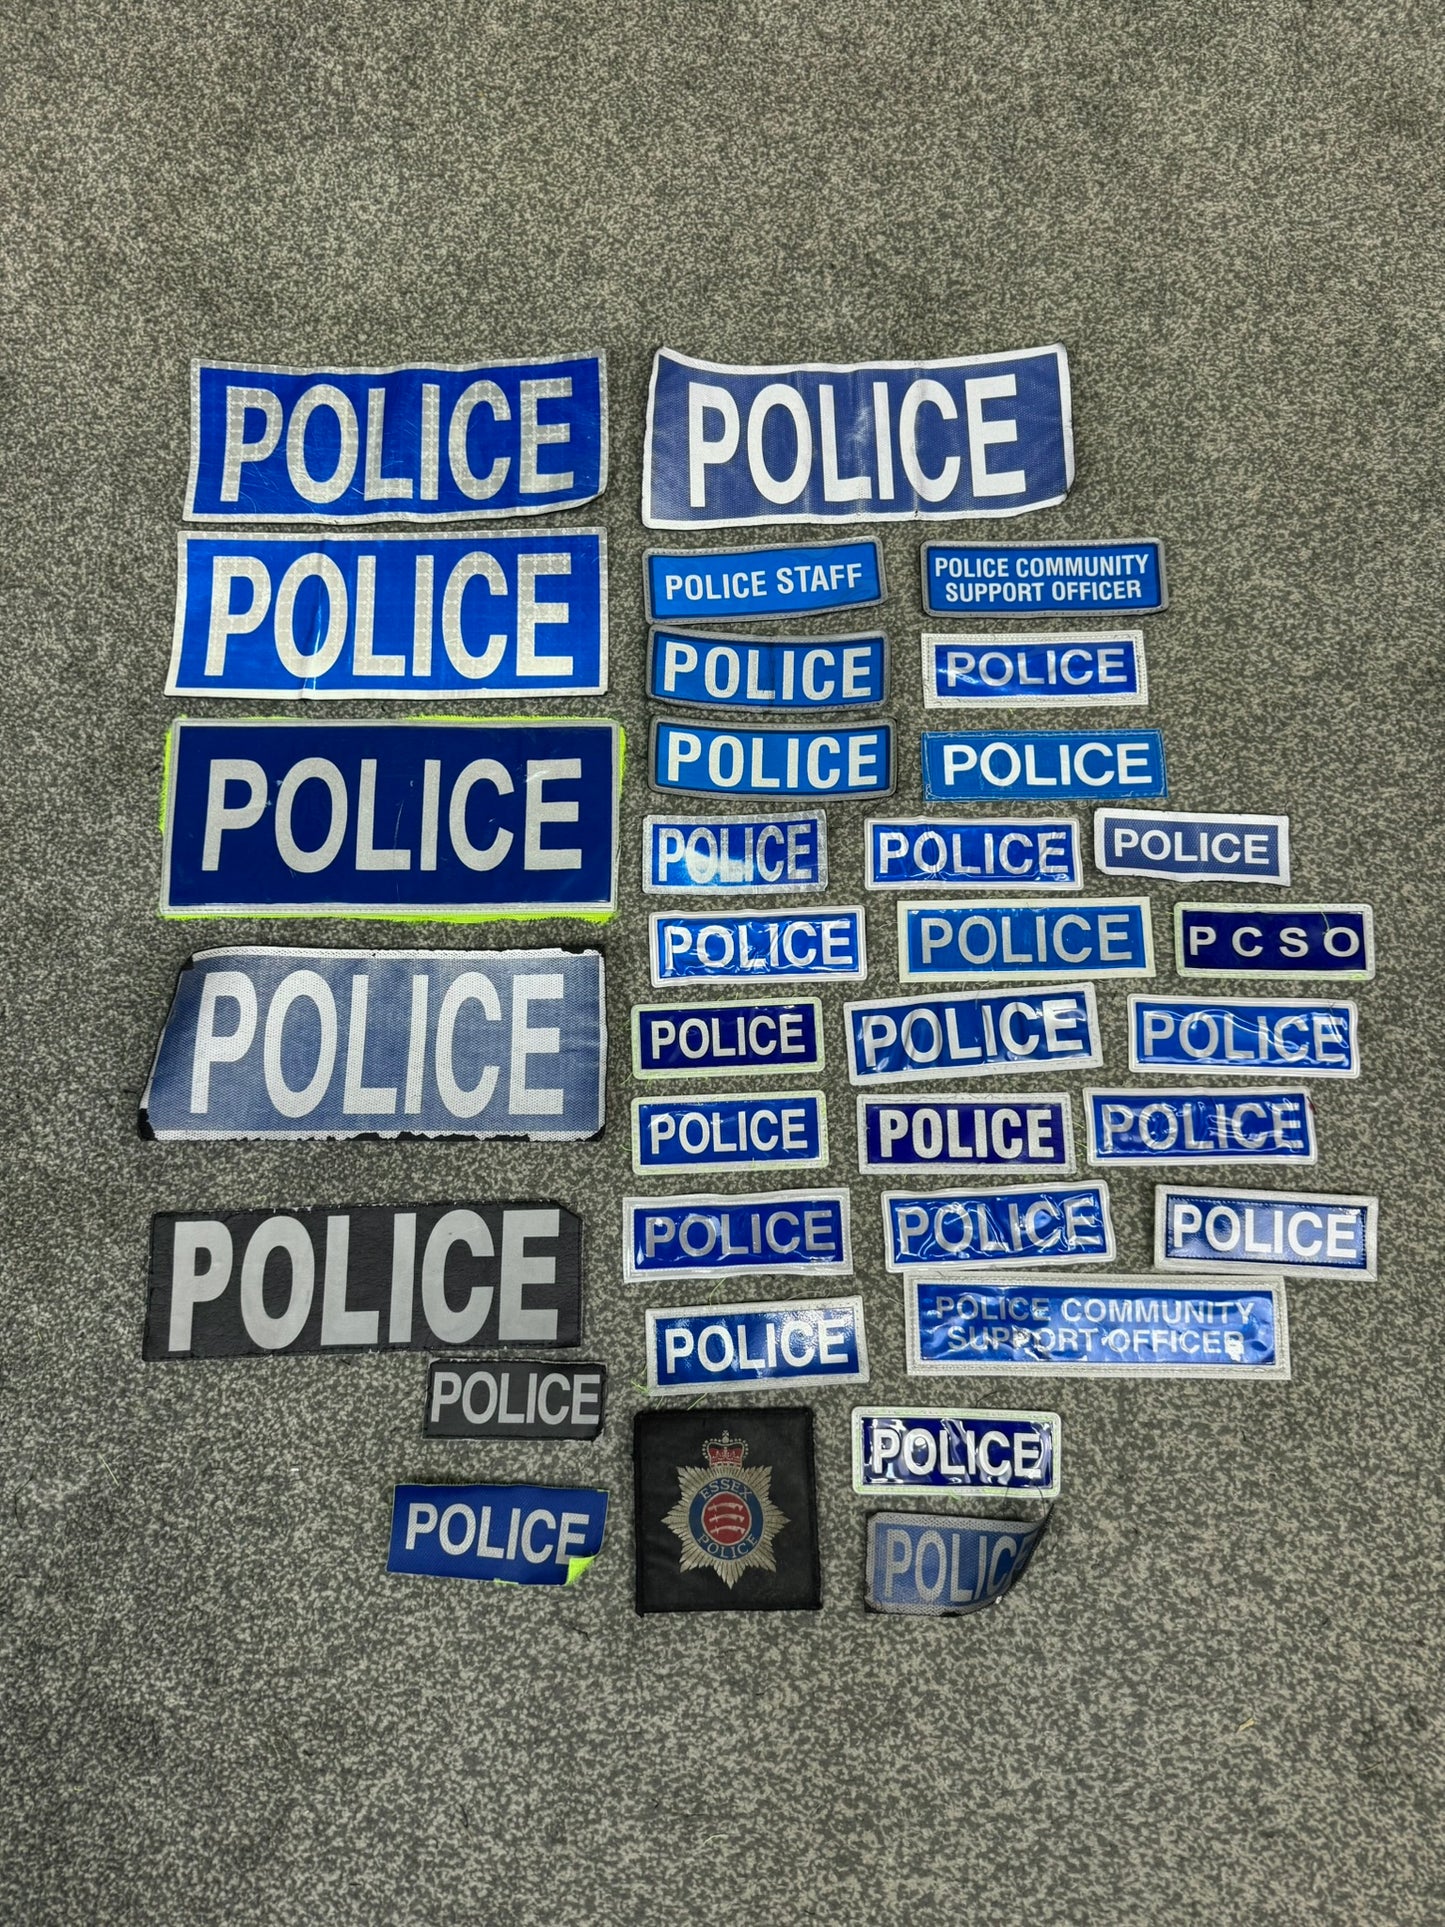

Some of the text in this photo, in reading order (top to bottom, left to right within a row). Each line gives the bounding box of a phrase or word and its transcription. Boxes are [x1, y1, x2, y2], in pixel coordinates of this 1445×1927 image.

[220, 376, 574, 504] POLICE
[688, 373, 1026, 508] POLICE
[665, 563, 863, 601] POLICE STAFF
[934, 554, 1149, 578] POLICE COMMUNITY
[945, 580, 1142, 603] SUPPORT OFFICER
[203, 551, 574, 679] POLICE
[663, 641, 872, 702] POLICE
[946, 648, 1127, 688] POLICE
[667, 731, 878, 789] POLICE
[942, 741, 1153, 786] POLICE
[201, 757, 582, 873] POLICE
[658, 824, 812, 885] POLICE
[880, 831, 1069, 876] POLICE
[1114, 828, 1270, 865] POLICE
[664, 920, 853, 971] POLICE
[920, 914, 1132, 965] POLICE
[190, 969, 565, 1119] POLICE
[651, 1014, 806, 1060] POLICE
[861, 999, 1083, 1068] POLICE
[1143, 1009, 1348, 1064] POLICE
[650, 1109, 808, 1155] POLICE
[879, 1108, 1056, 1160] POLICE
[1101, 1103, 1304, 1153] POLICE
[645, 1209, 836, 1258] POLICE
[896, 1195, 1102, 1255] POLICE
[1173, 1203, 1357, 1259] POLICE
[167, 1208, 560, 1352] POLICE
[935, 1296, 1255, 1325] POLICE COMMUNITY
[665, 1317, 849, 1374] POLICE
[947, 1324, 1244, 1356] SUPPORT OFFICER
[430, 1371, 600, 1425] POLICE
[871, 1427, 1042, 1479] POLICE
[700, 1479, 753, 1500] ESSEX
[405, 1502, 591, 1565] POLICE
[698, 1533, 758, 1560] POLICE
